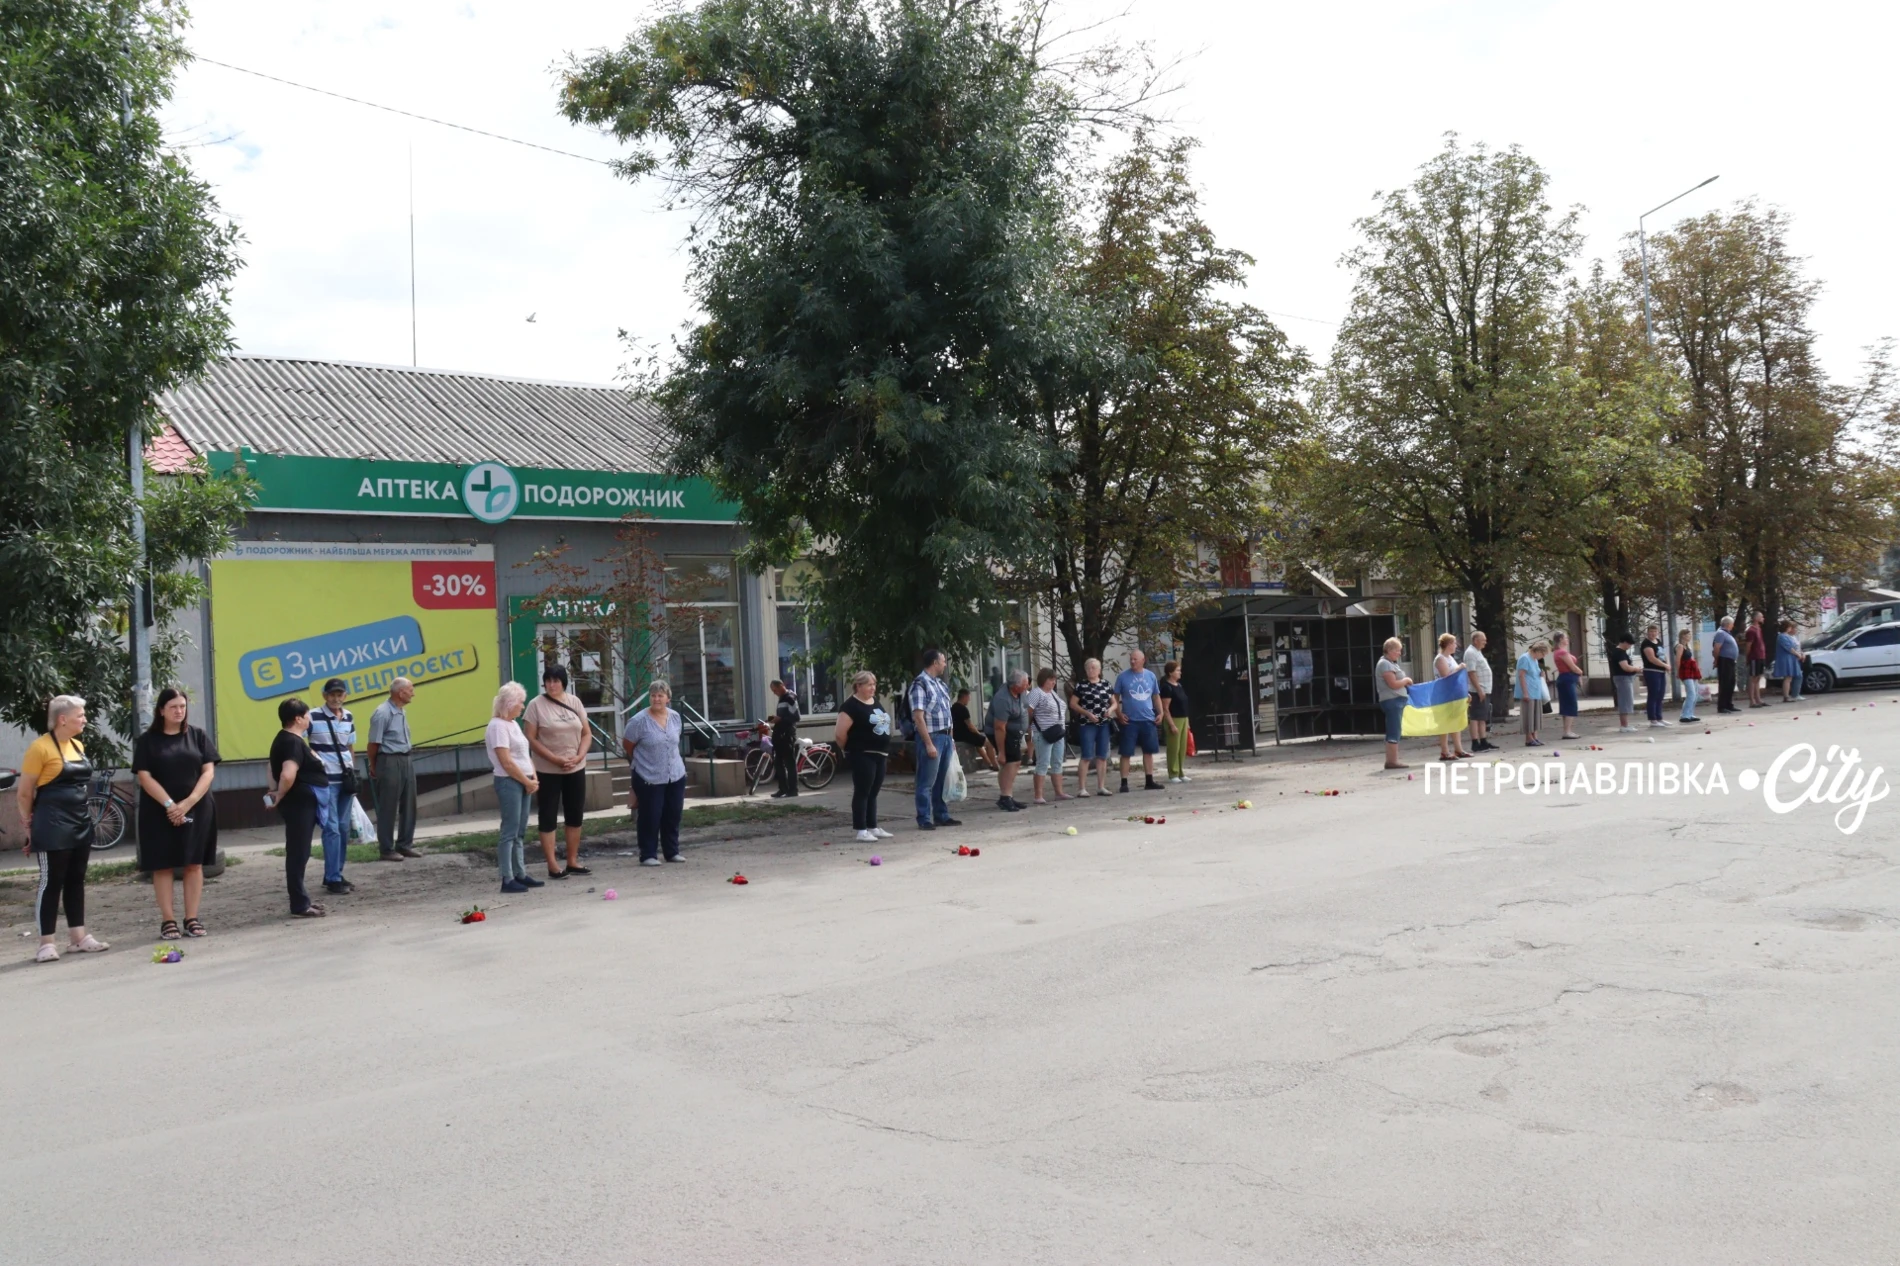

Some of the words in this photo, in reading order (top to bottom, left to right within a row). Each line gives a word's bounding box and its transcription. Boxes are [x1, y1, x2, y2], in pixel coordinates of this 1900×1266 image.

[357, 477, 459, 501] АПТЕКА
[524, 484, 686, 508] ПОДОРОЖНИК
[245, 546, 314, 556] ПОДОРОЖНИК
[319, 546, 372, 556] НАЙБІЛЬША
[373, 548, 409, 556] МЕРЕЖА
[410, 548, 437, 556] АПТЕК
[422, 574, 487, 597] -30%
[322, 650, 465, 695] ЕЦПРОЄКТ
